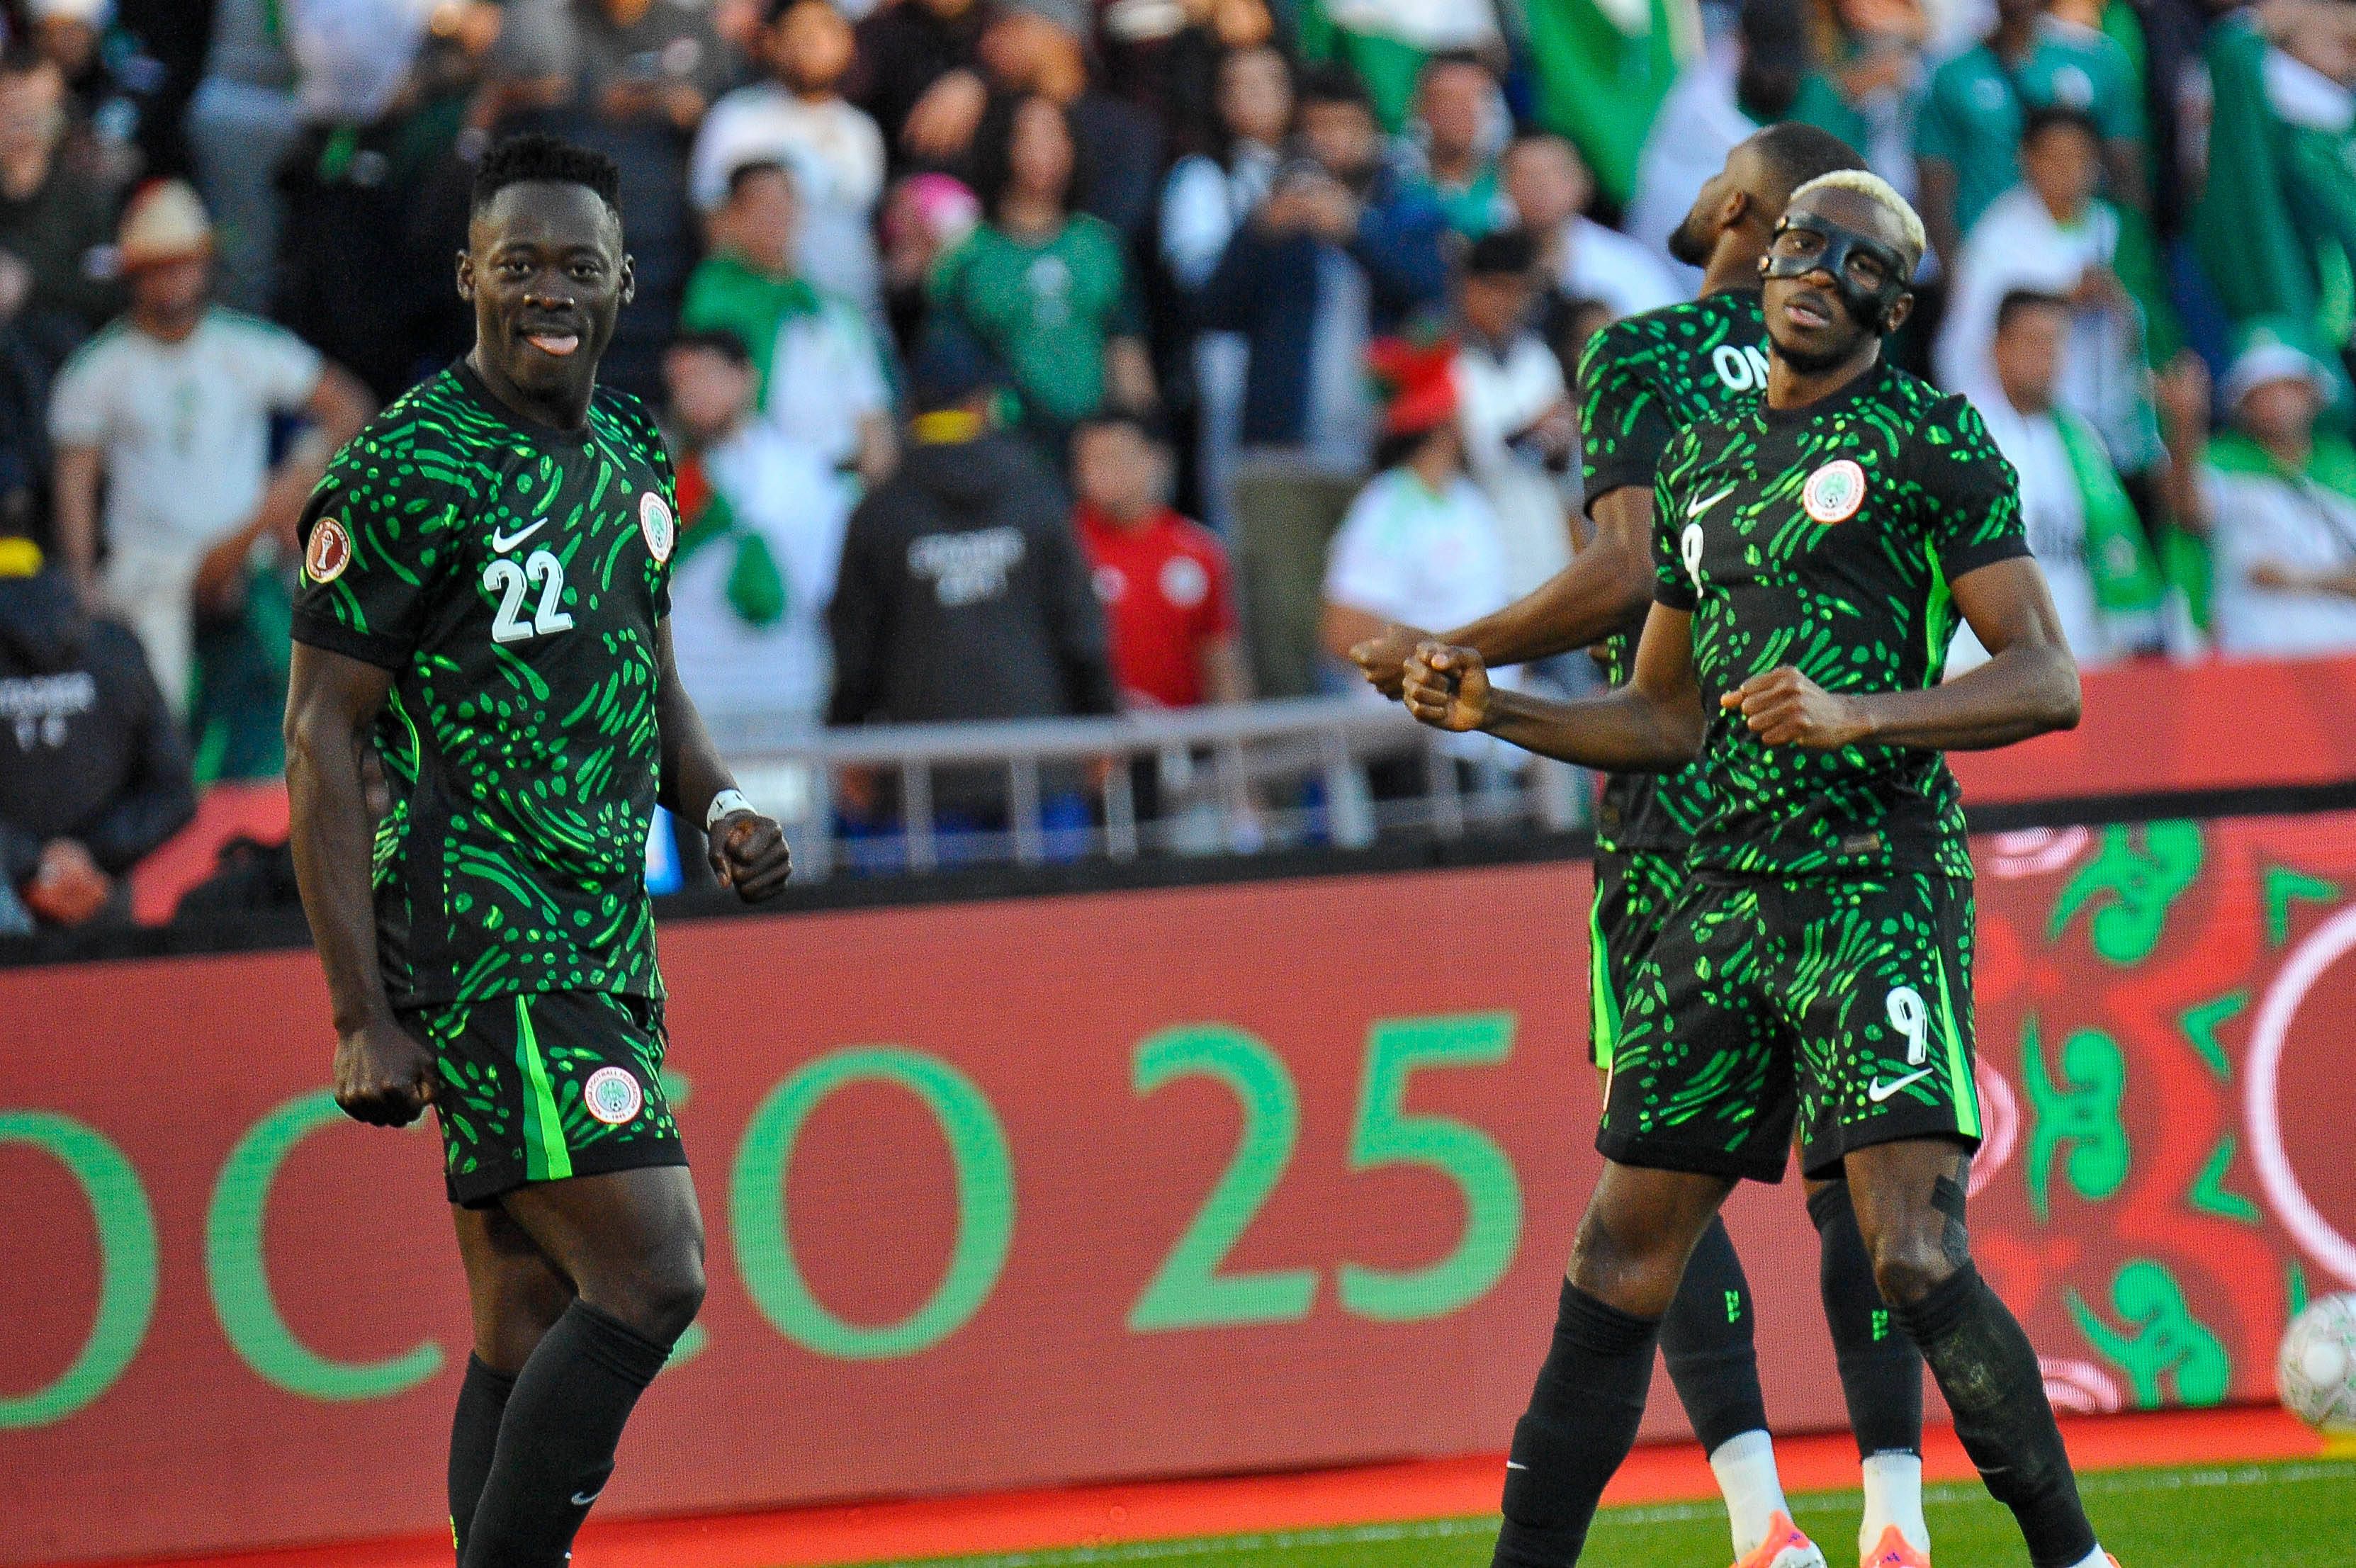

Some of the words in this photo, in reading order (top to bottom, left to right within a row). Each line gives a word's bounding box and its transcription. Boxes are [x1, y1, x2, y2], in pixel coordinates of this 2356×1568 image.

[483, 549, 573, 643] 22
[1886, 985, 1928, 1065] 9
[1129, 1011, 1523, 1331] 25
